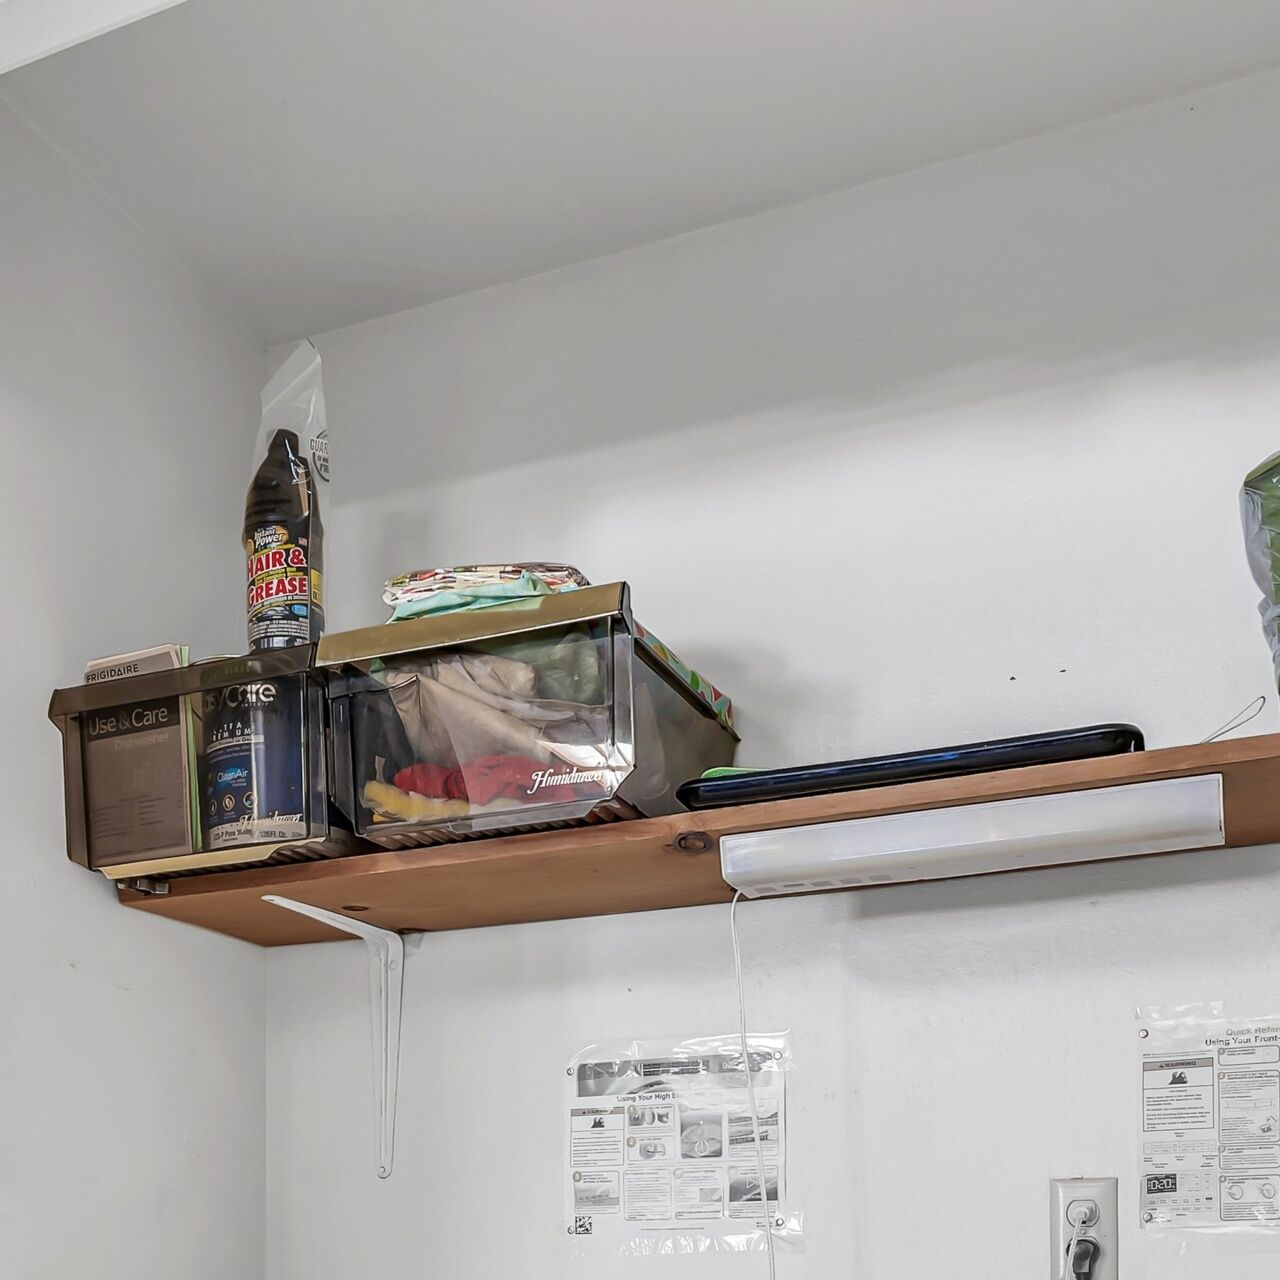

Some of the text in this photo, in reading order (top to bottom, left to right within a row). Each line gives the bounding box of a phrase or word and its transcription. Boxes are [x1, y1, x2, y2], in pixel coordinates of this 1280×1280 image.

[255, 533, 285, 550] Power
[247, 549, 287, 581] HAIR
[288, 546, 308, 568] &
[247, 576, 308, 611] GREASE
[86, 664, 140, 684] FRIGIDAIRE
[89, 717, 117, 736] Use
[131, 707, 169, 728] Care
[1205, 1038, 1230, 1046] Using
[1231, 1036, 1251, 1044] Your
[1225, 1028, 1252, 1036] Quick
[654, 1092, 670, 1101] High
